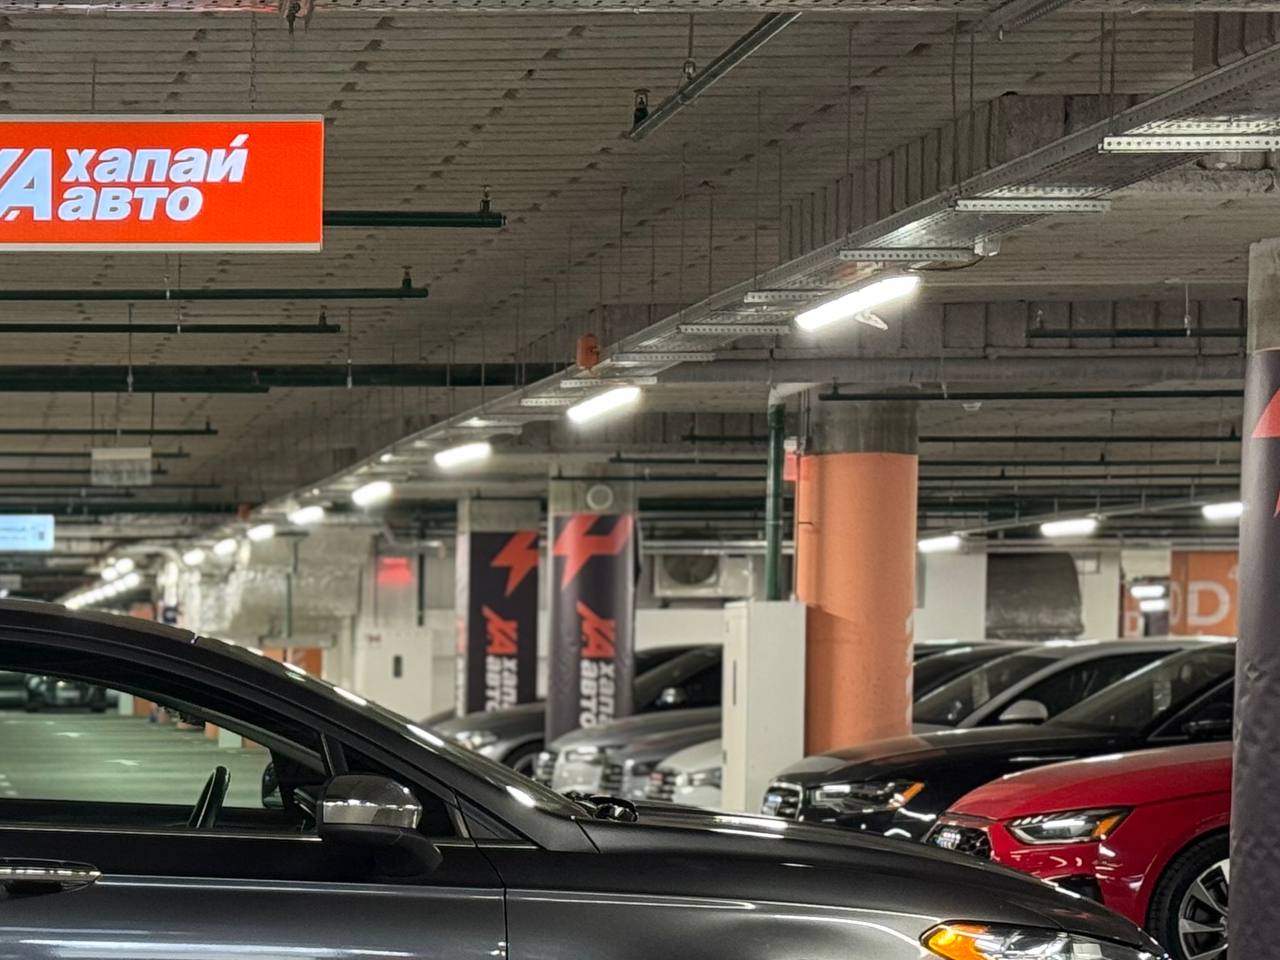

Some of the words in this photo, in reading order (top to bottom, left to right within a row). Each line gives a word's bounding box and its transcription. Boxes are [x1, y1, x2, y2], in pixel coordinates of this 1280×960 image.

[61, 133, 250, 183] хапай
[58, 186, 205, 222] авто
[1187, 580, 1230, 626] D
[579, 658, 598, 728] авто
